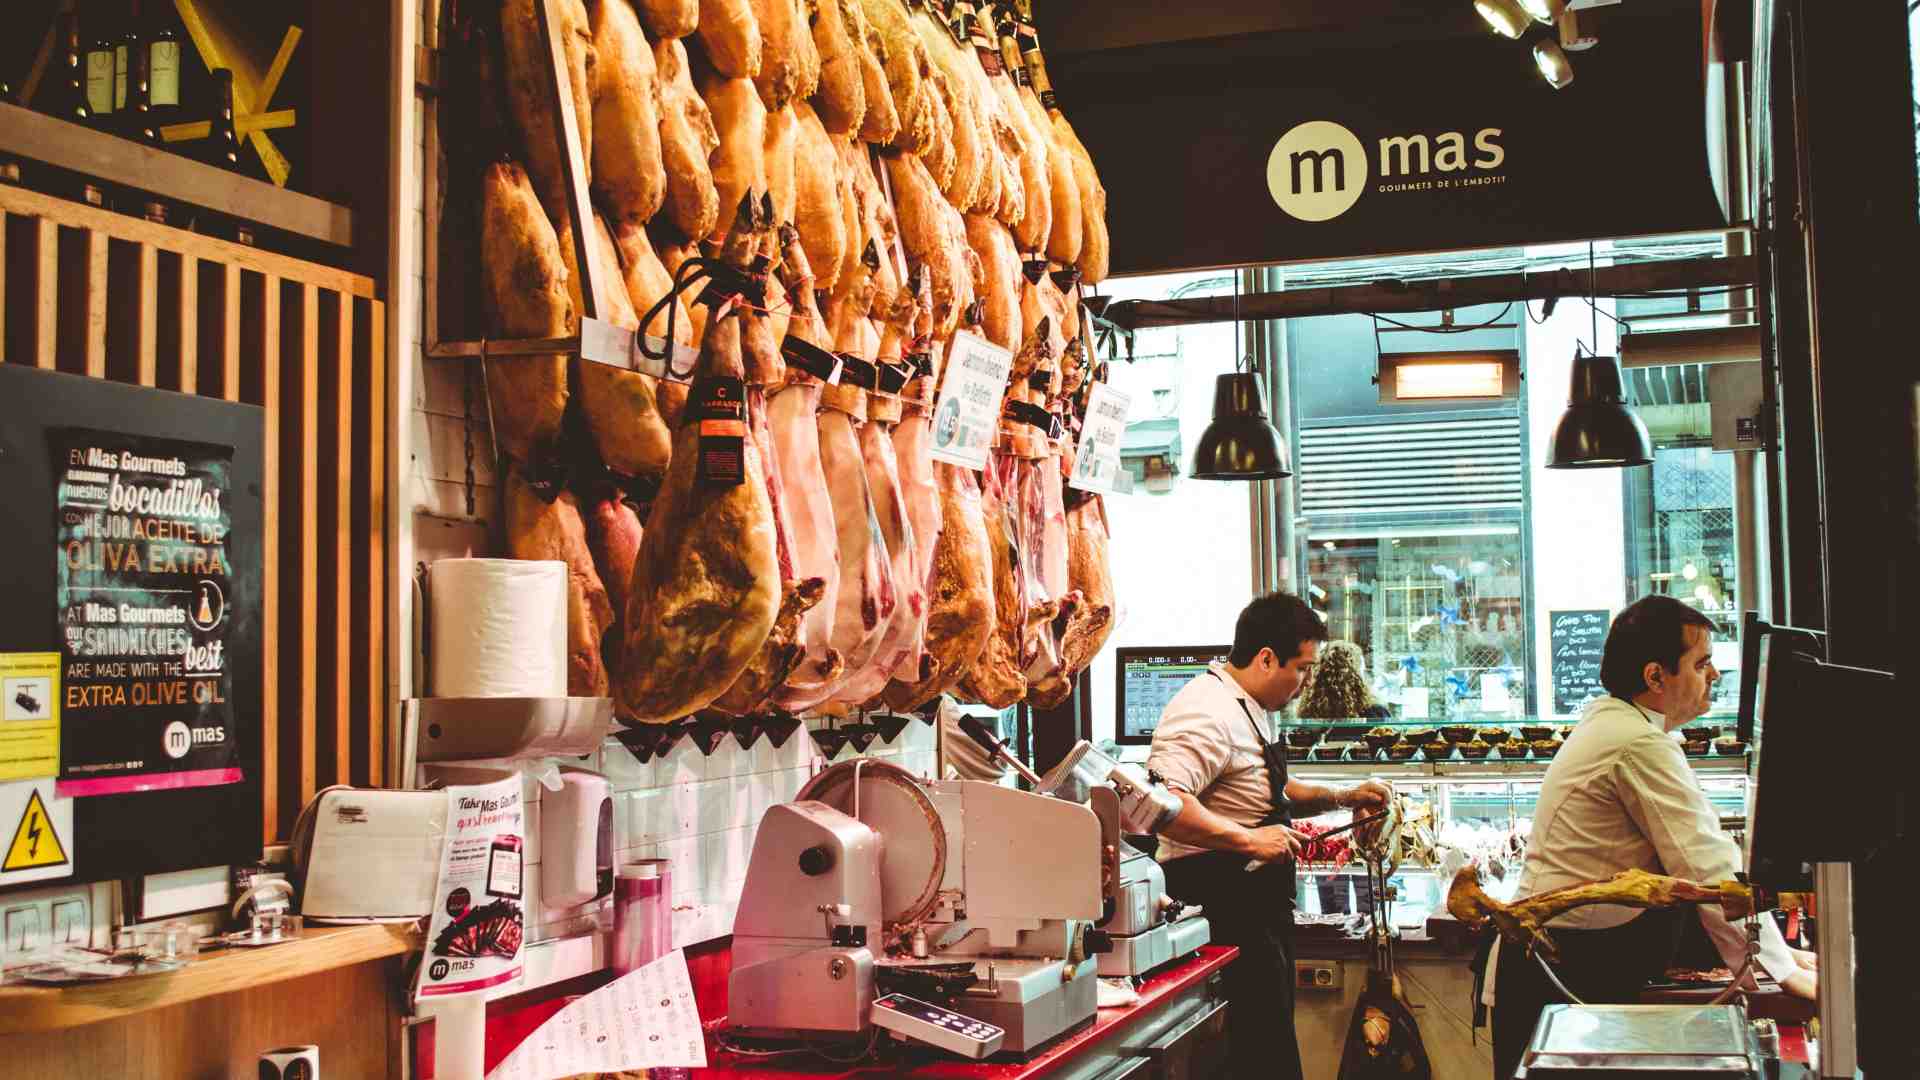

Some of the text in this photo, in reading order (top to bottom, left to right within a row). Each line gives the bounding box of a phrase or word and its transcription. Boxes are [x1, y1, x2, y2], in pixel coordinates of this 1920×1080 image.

[1378, 128, 1505, 177] mas
[1379, 175, 1506, 193] GOURMETS DE L'EMBOTIT
[70, 447, 187, 476] EN Mas Gourmets
[67, 484, 109, 500] nuestros
[109, 473, 221, 519] bocadillos
[84, 512, 224, 546] MEJOR ACEITE DE
[66, 540, 225, 576] OLIVA EXTRA
[66, 603, 187, 625] AT Mas Gourmets
[185, 635, 224, 671] best
[68, 662, 91, 679] ARE
[96, 662, 127, 679] MADE
[131, 662, 160, 678] WITH
[163, 662, 183, 678] THE
[66, 680, 226, 709] EXTRA OLIVE OIL
[192, 725, 226, 743] mas
[459, 797, 480, 810] Take
[480, 799, 499, 814] Mas
[451, 960, 475, 971] mas
